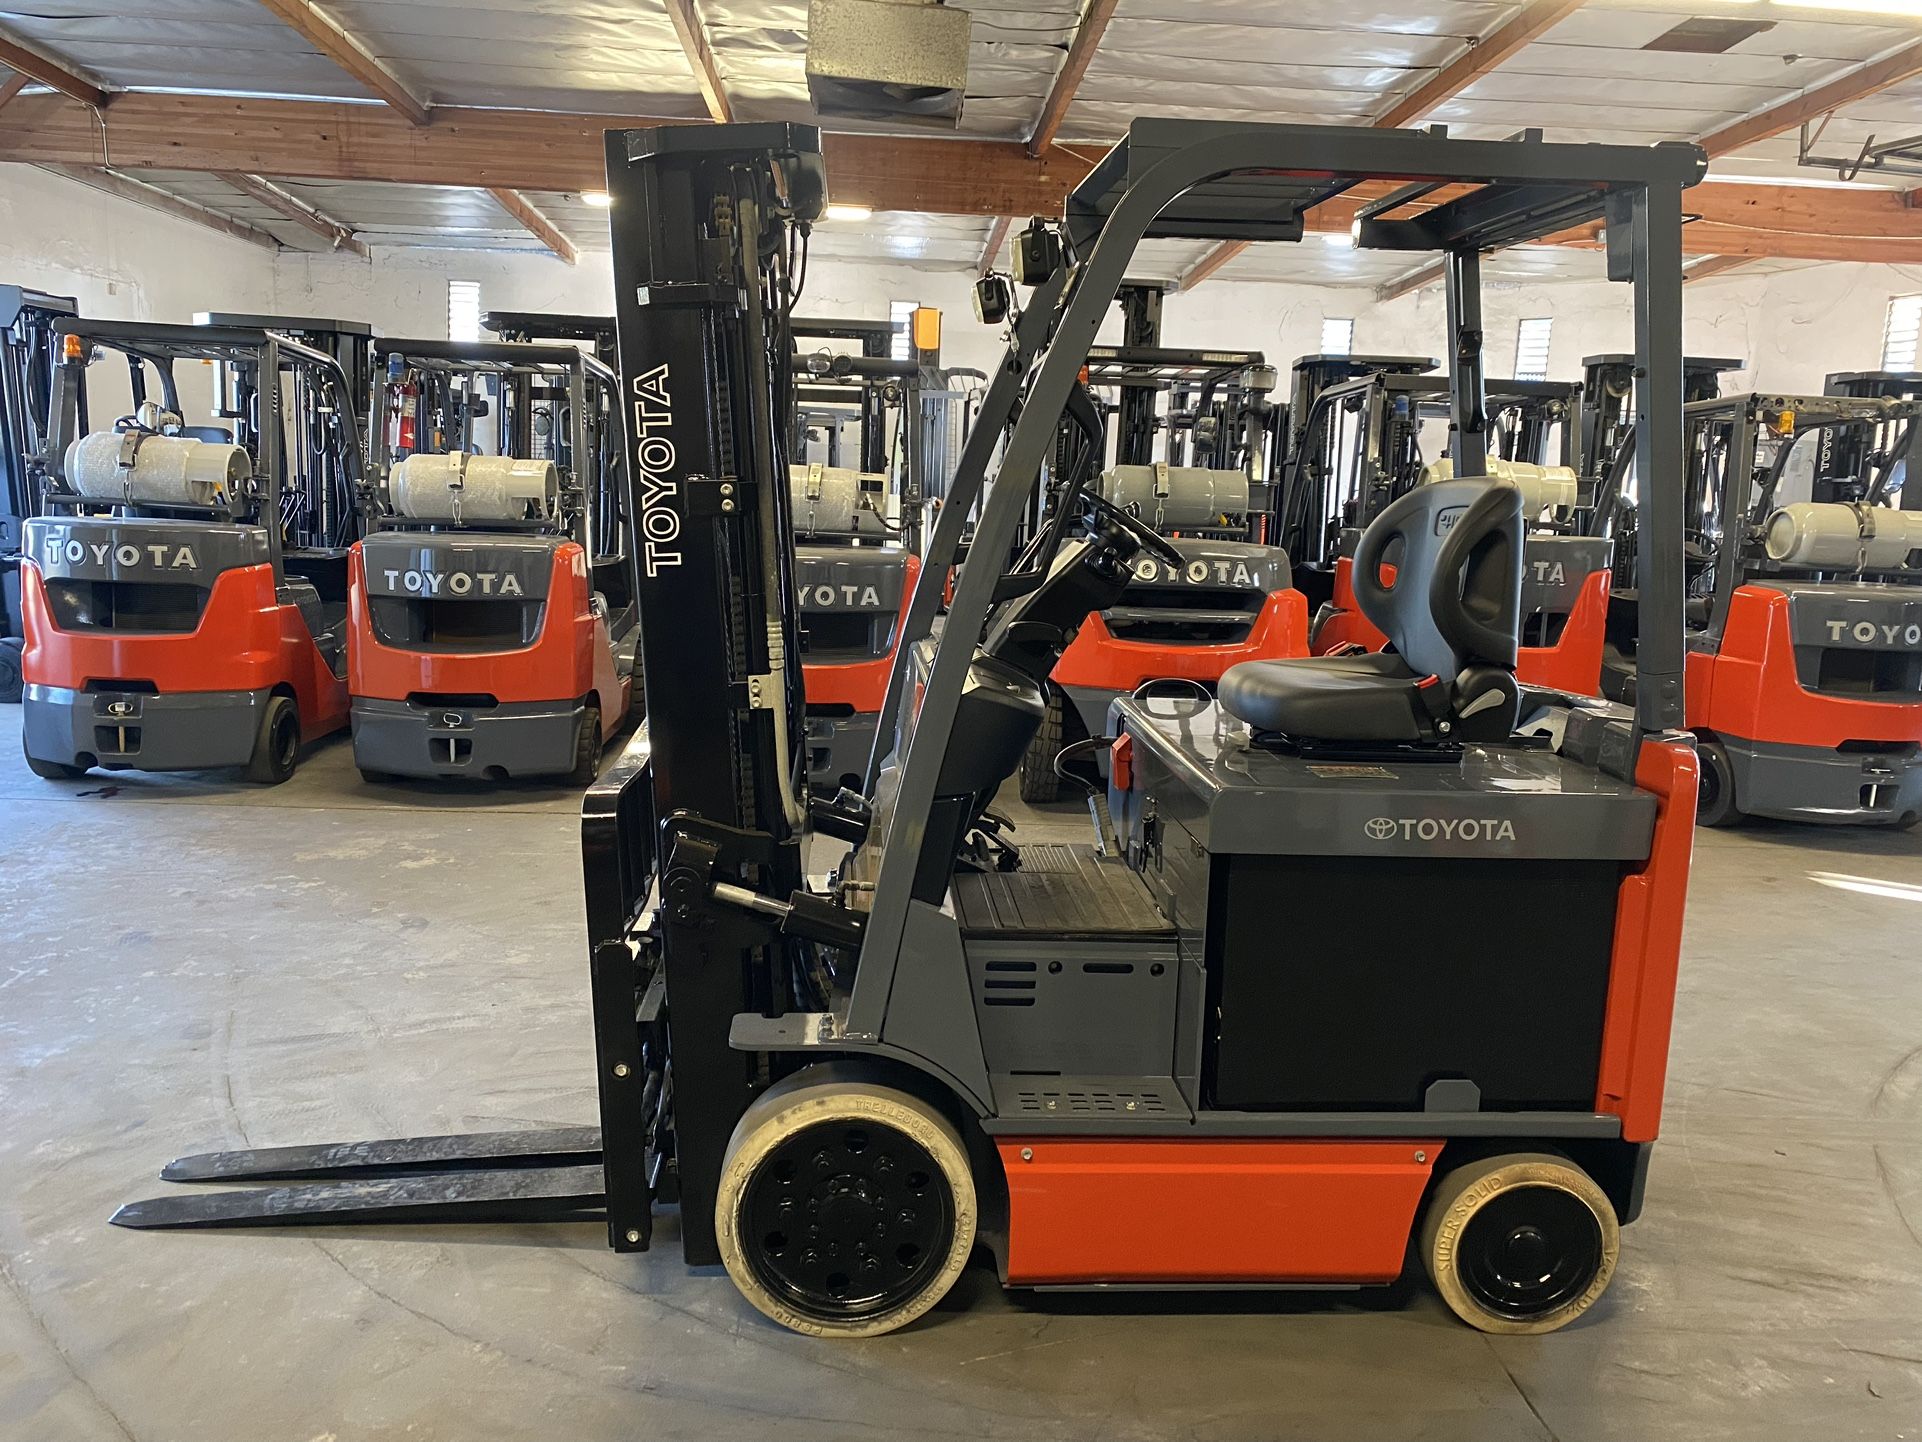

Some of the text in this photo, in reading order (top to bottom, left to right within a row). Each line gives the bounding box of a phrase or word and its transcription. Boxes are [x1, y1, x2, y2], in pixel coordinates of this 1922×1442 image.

[633, 363, 683, 578] TOYOTA
[46, 537, 199, 570] TOYOTA
[383, 569, 524, 598] TOYOTA
[1127, 559, 1252, 584] OYOTA
[1522, 561, 1565, 583] TA
[1826, 620, 1922, 645] TOYO
[1398, 818, 1516, 842] TOYOTA
[1437, 1177, 1503, 1271] SUPER SOLID
